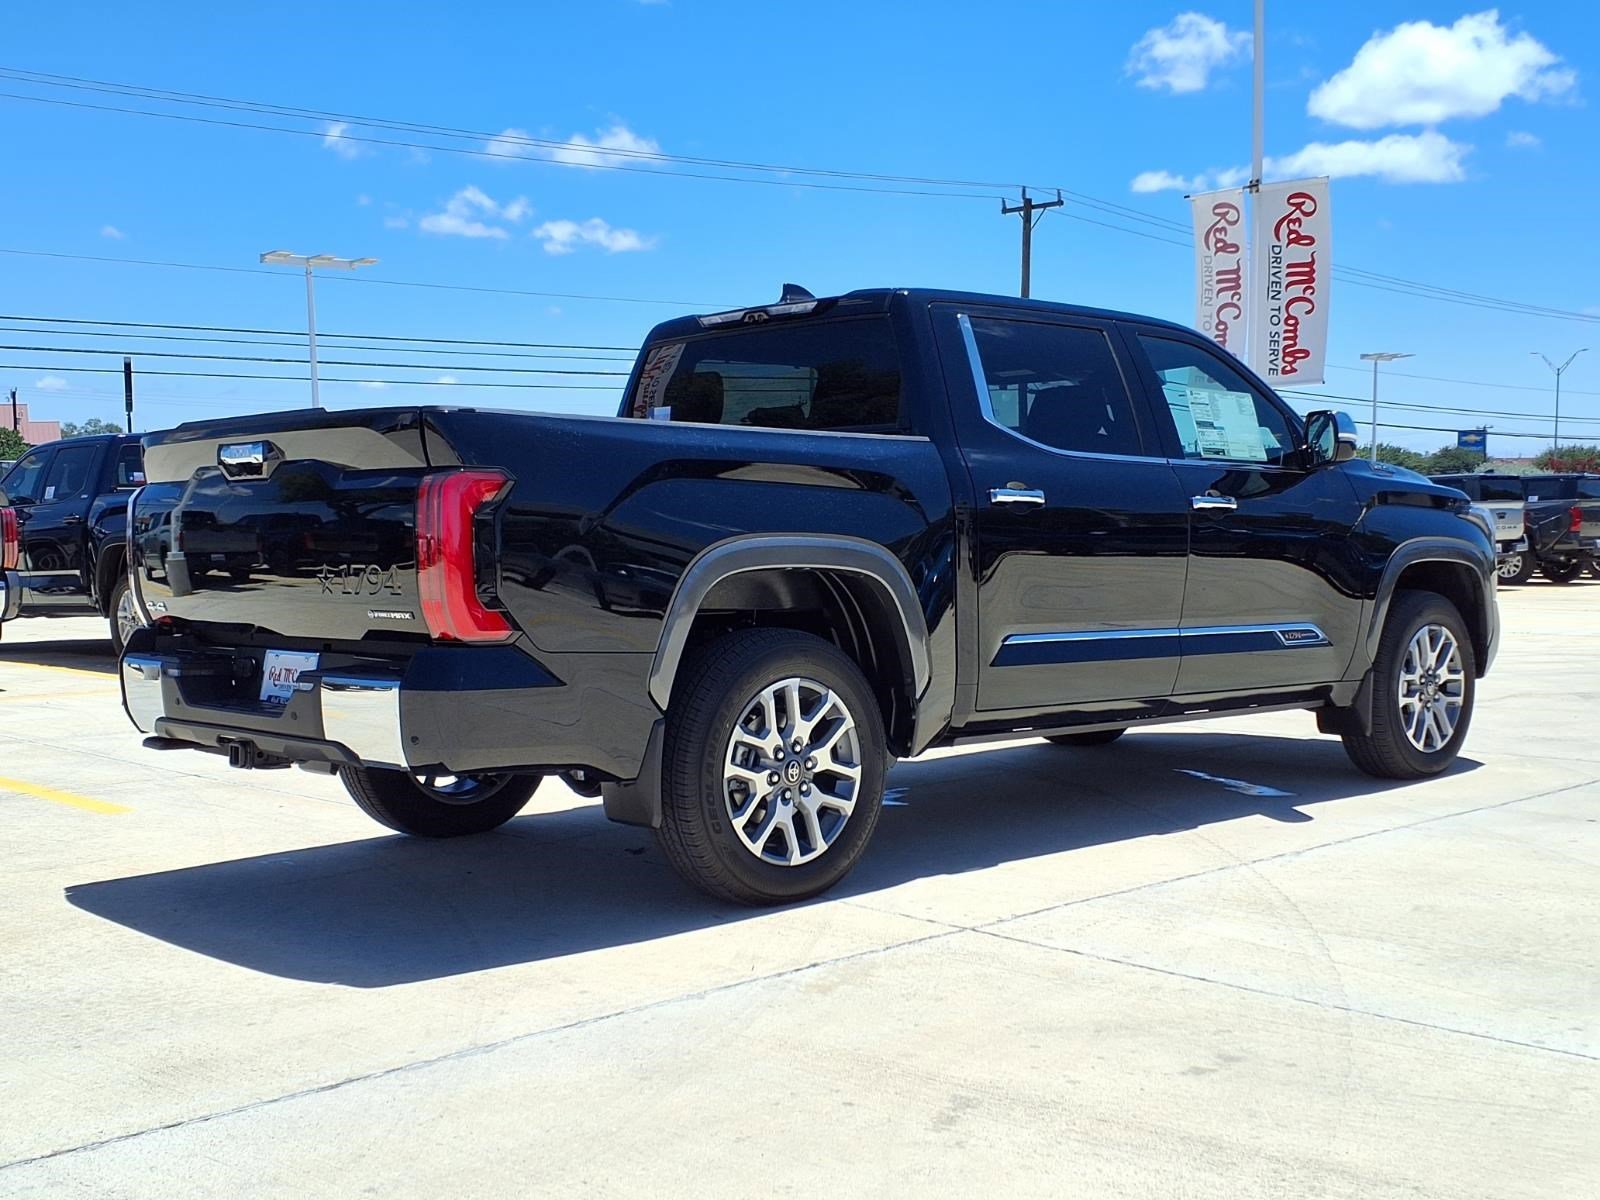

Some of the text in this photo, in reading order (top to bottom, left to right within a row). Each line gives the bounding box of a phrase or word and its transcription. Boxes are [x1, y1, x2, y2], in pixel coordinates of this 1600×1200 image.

[1203, 256, 1213, 331] DRIVEN TO
[1204, 202, 1242, 348] Red McCom
[1268, 245, 1282, 376] DRIVEN TO SERVE
[1274, 192, 1317, 376] Red McCombs
[339, 564, 402, 595] 1794
